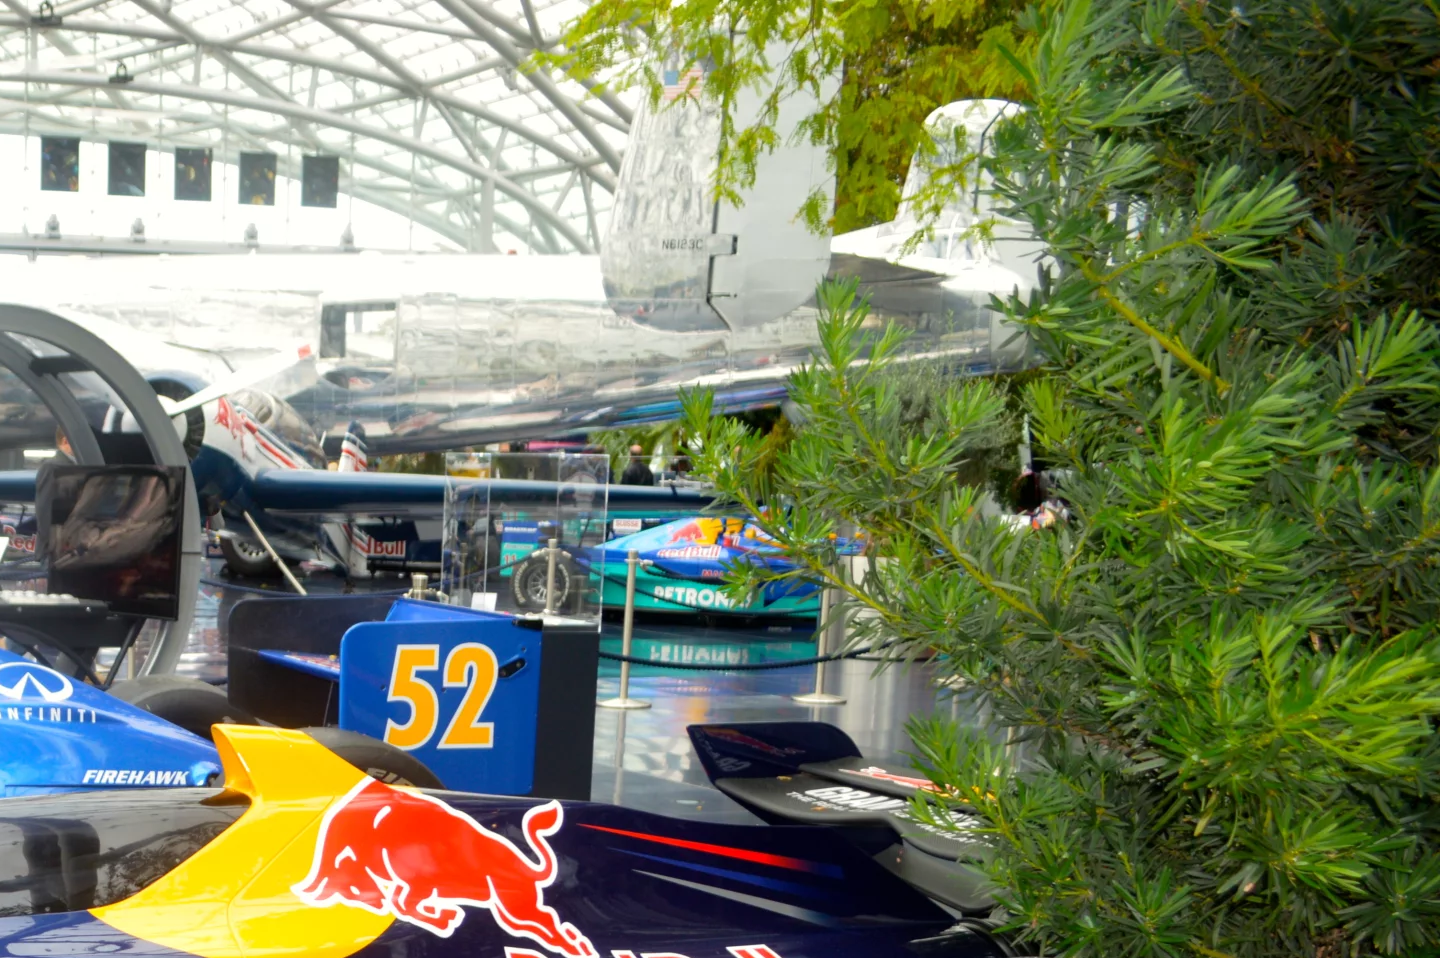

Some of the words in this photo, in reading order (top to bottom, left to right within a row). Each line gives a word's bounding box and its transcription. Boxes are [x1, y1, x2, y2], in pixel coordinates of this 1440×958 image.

[662, 239, 704, 250] N6123C
[383, 642, 499, 751] 52
[82, 769, 190, 785] FIREHAWK
